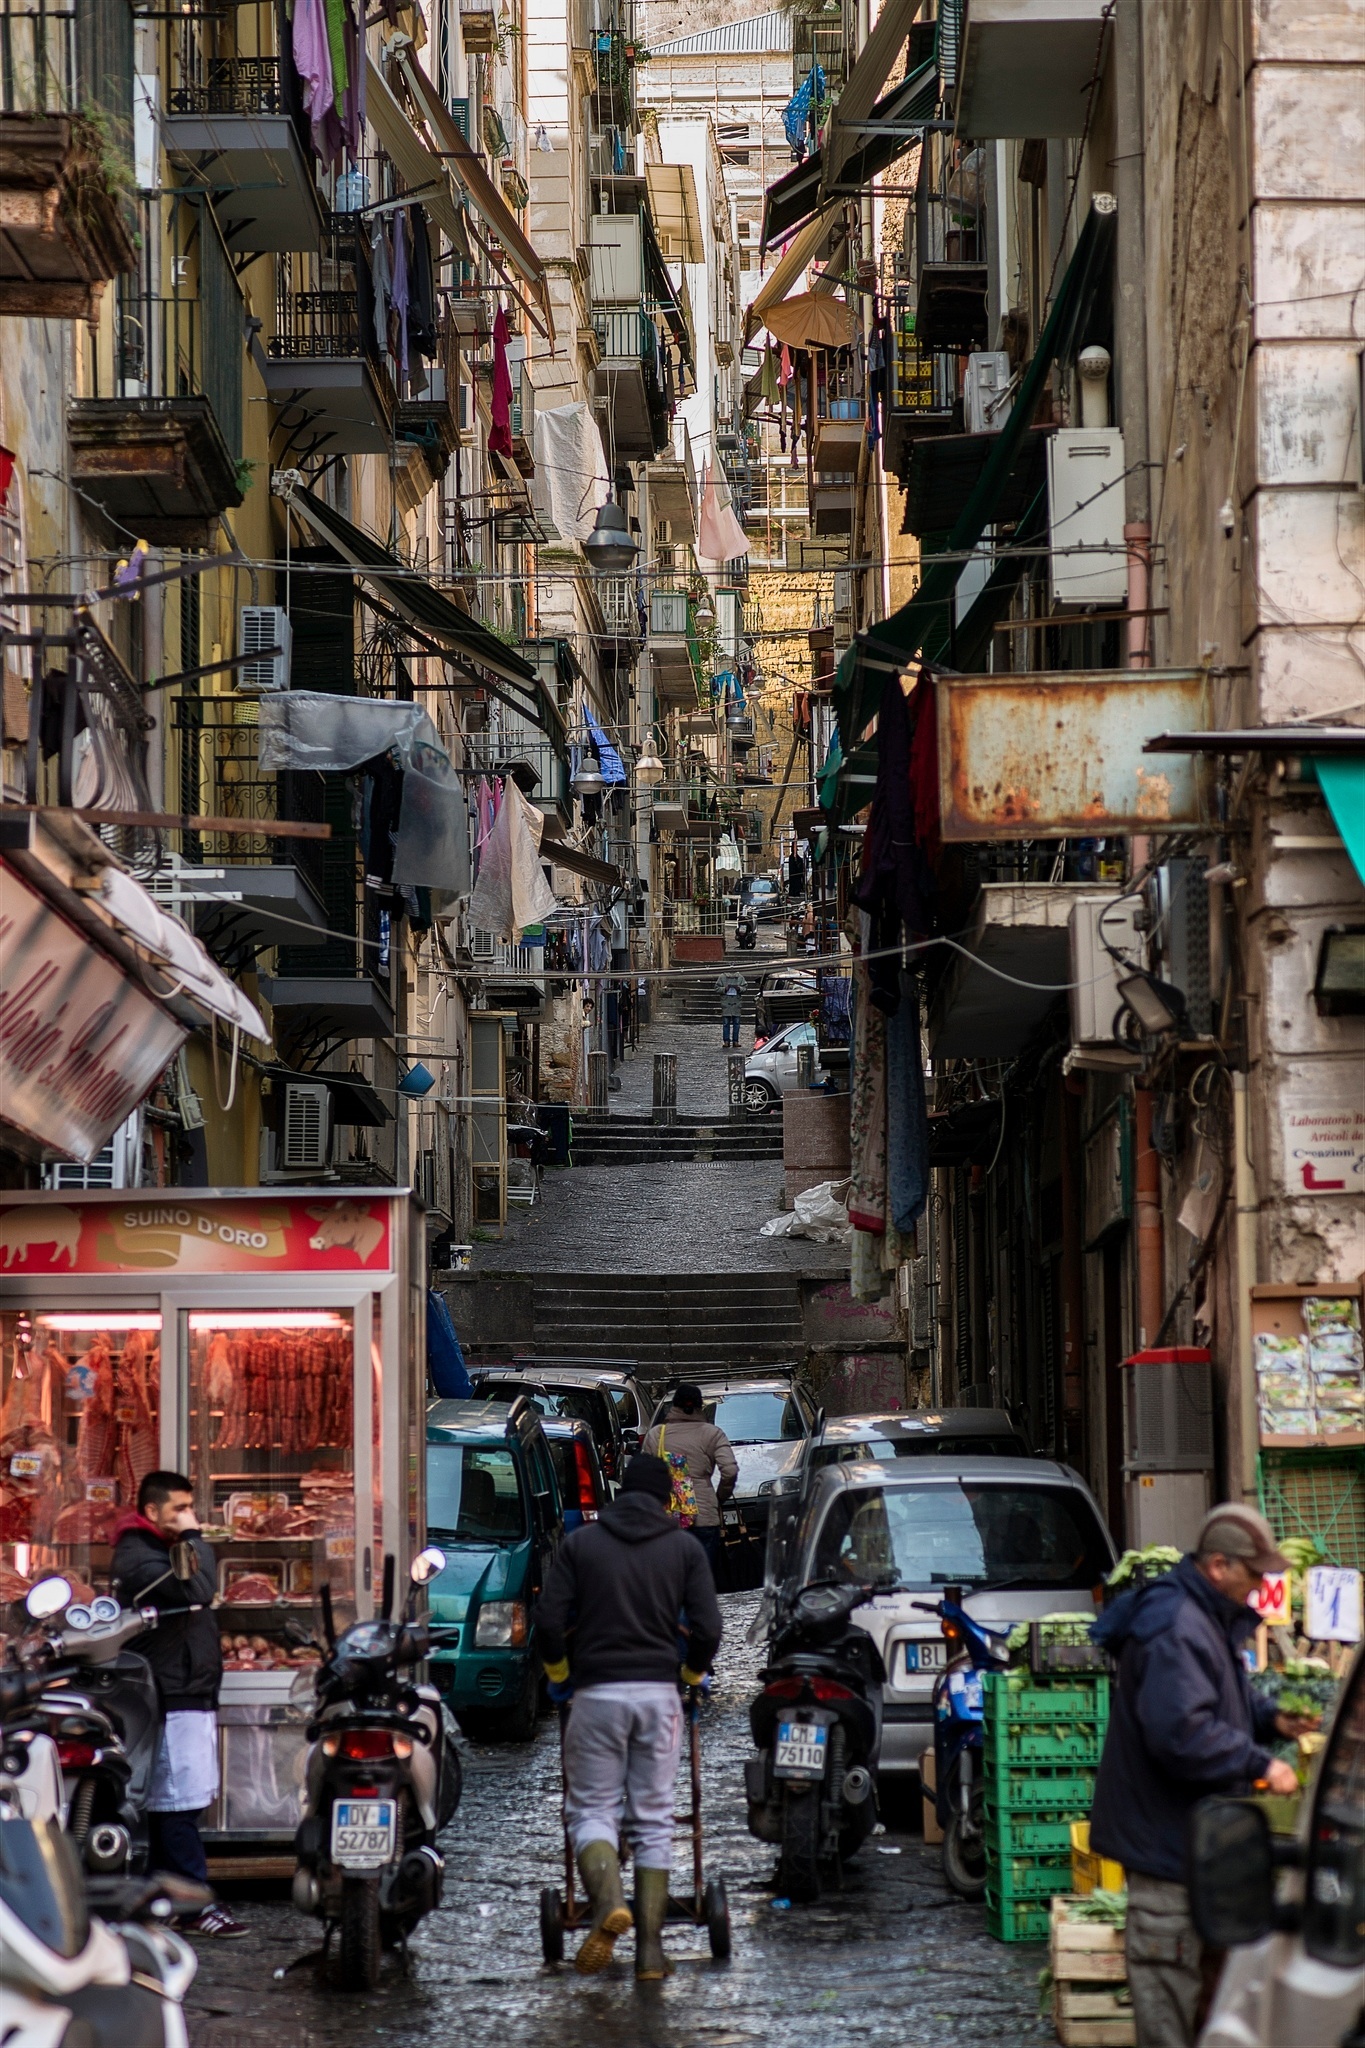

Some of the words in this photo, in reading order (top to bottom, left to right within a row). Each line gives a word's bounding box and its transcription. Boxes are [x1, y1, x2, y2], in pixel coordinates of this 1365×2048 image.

[1290, 1115, 1351, 1127] Laboratorio
[1311, 1131, 1348, 1142] Articoli
[124, 1209, 191, 1227] SUINO
[197, 1216, 268, 1248] D'ORO
[791, 1726, 808, 1743] CM
[780, 1746, 823, 1765] 75110
[351, 1806, 370, 1826] DY
[338, 1830, 387, 1850] 52787
